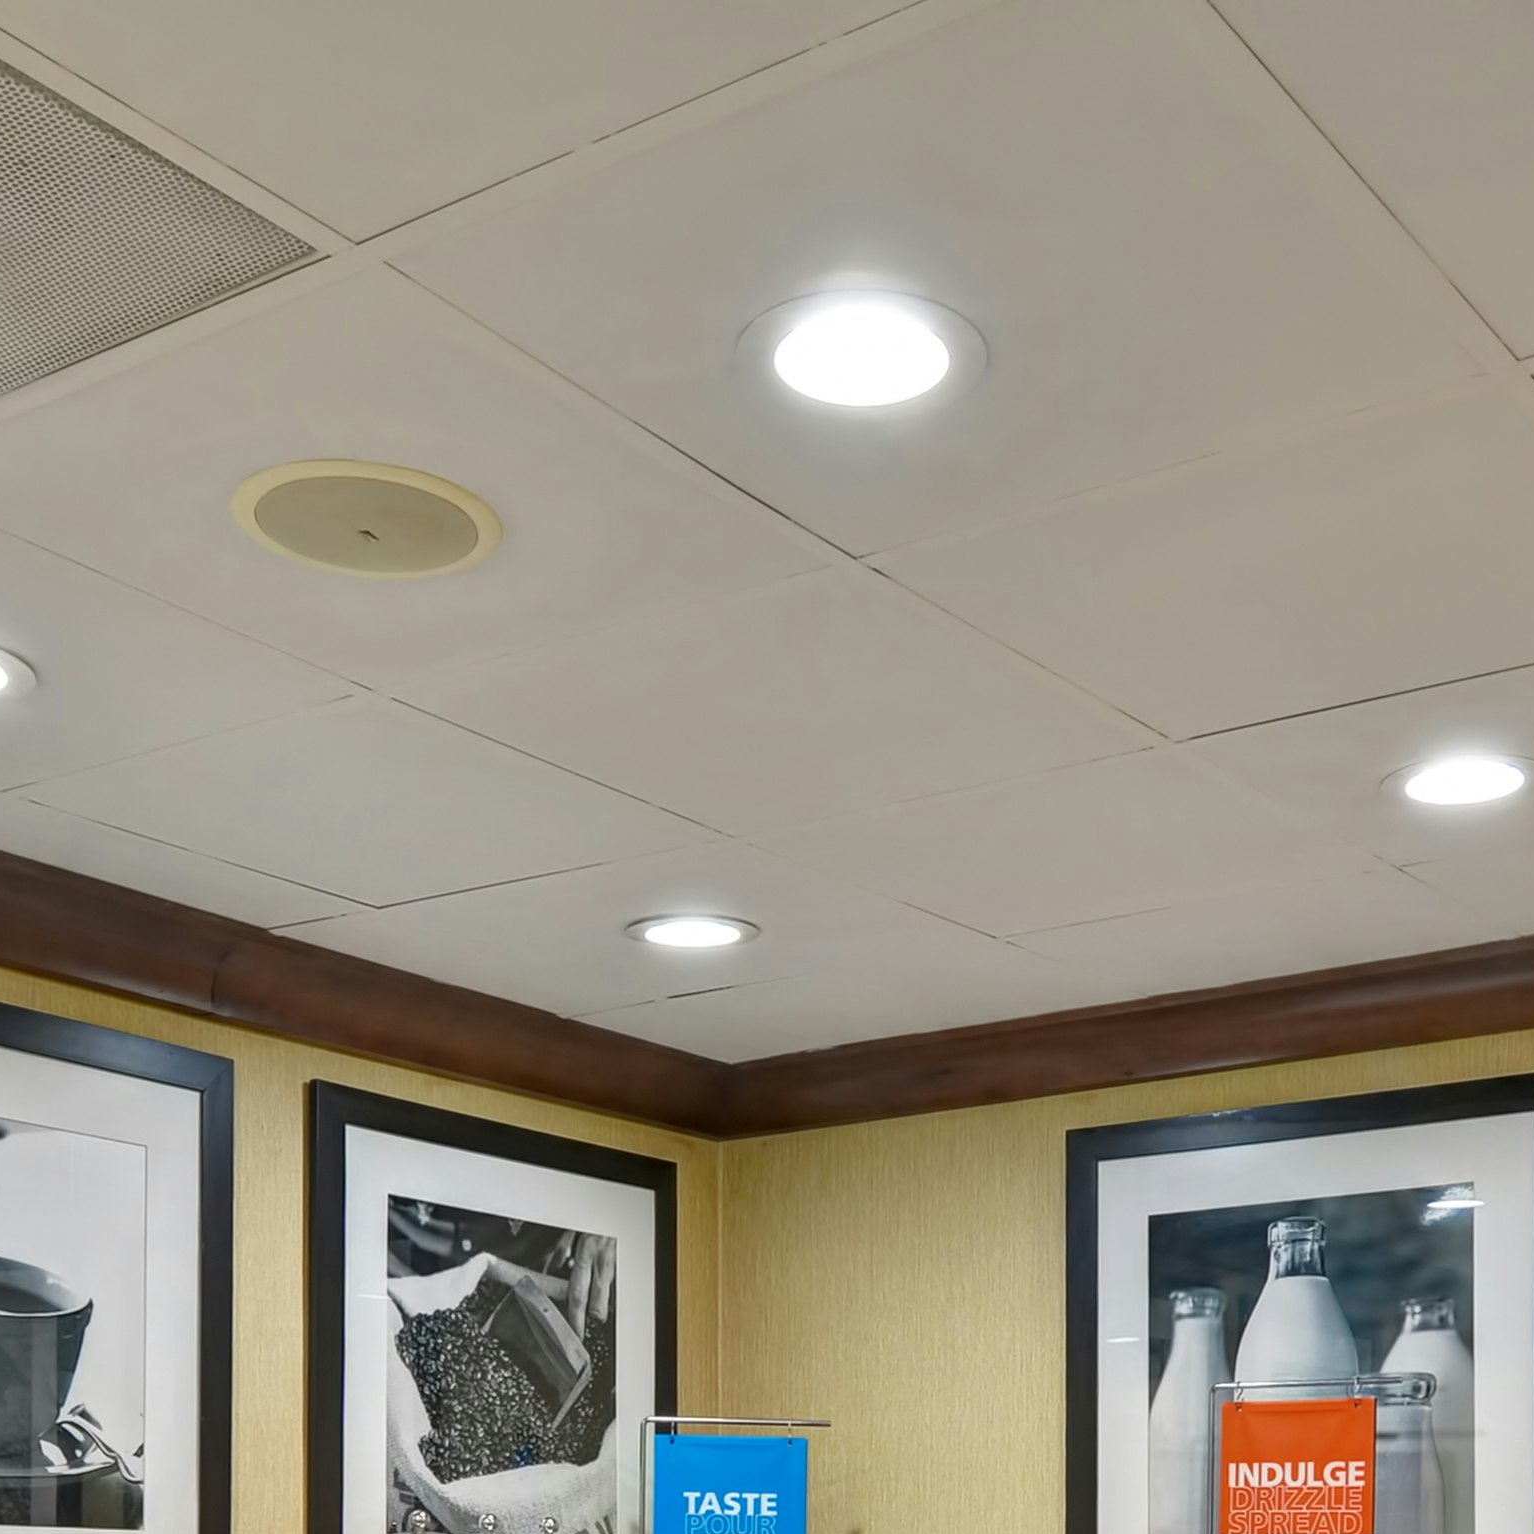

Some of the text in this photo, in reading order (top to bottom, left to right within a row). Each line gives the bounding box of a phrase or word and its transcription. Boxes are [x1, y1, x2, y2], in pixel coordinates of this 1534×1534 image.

[1228, 1461, 1366, 1488] INDULGE
[683, 1491, 778, 1516] TASTE
[1230, 1485, 1363, 1512] DRIZZLE
